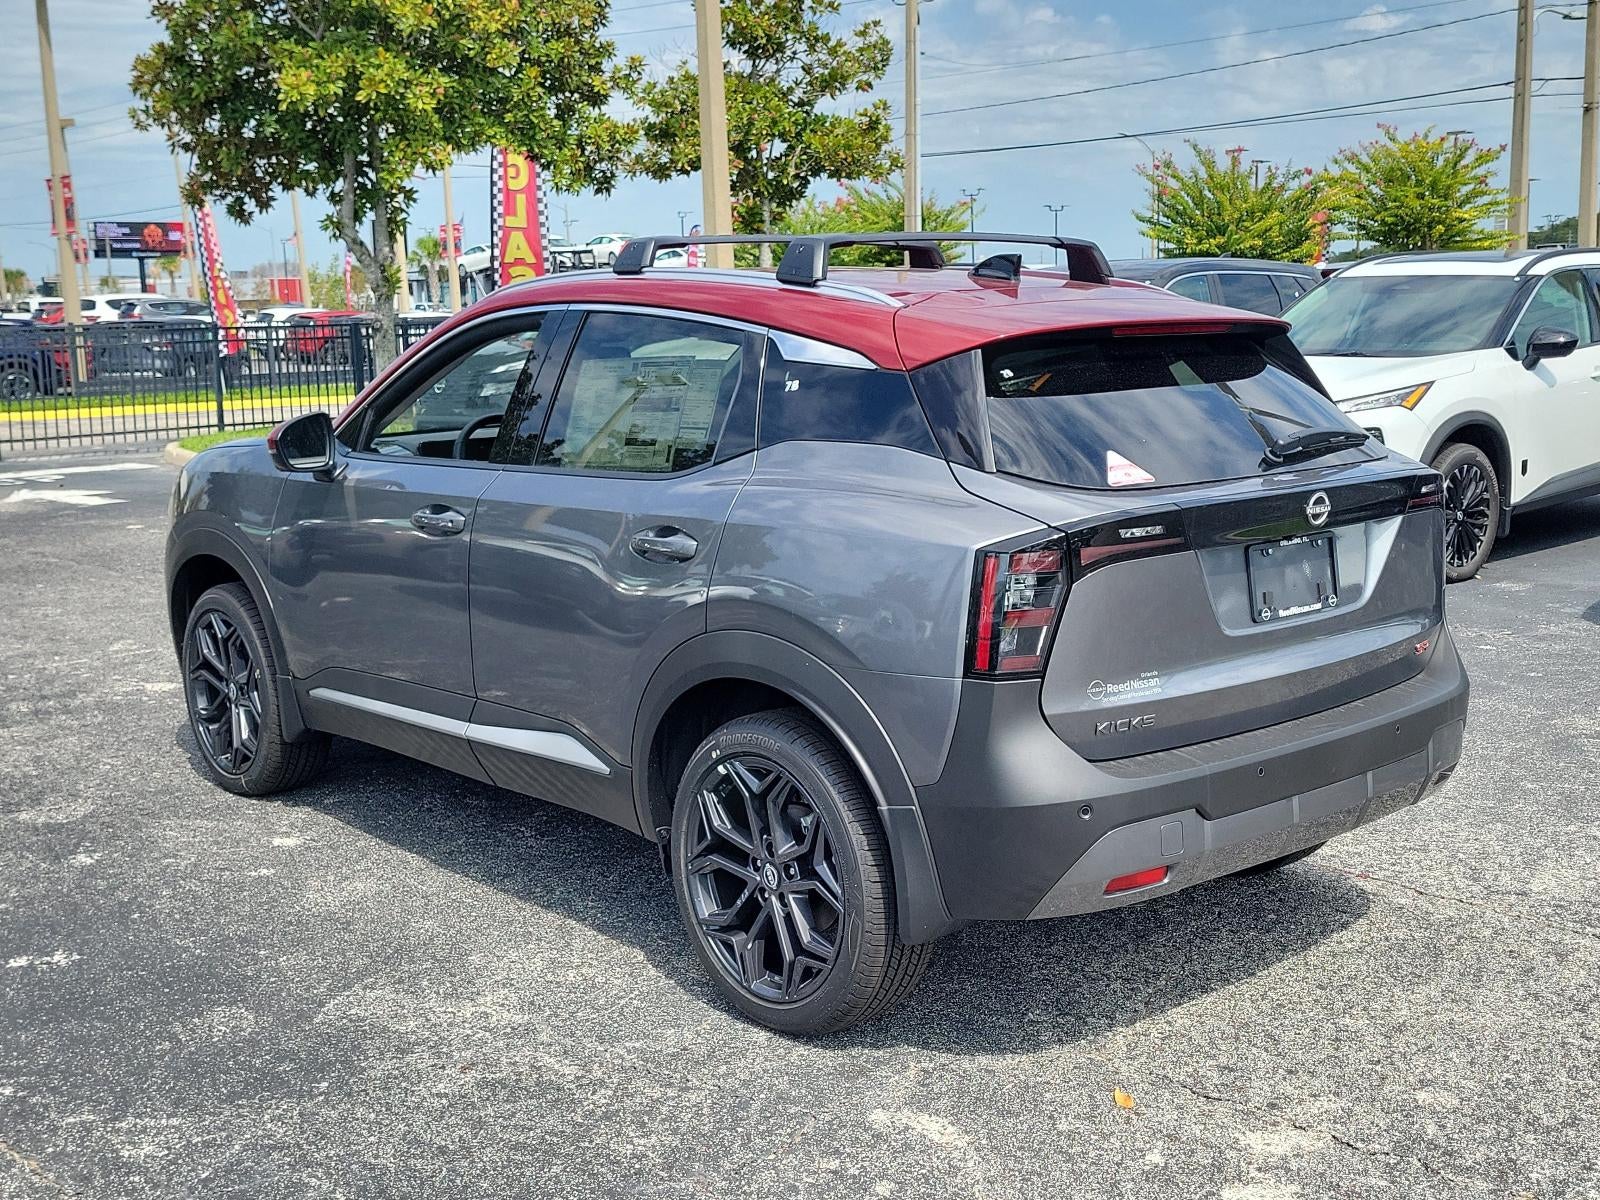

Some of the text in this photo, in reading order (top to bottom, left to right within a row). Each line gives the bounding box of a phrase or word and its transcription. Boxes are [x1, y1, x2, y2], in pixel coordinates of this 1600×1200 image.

[1306, 503, 1331, 514] NISSAN
[1094, 713, 1156, 736] KICKS
[719, 733, 781, 752] BRIDGESTONE
